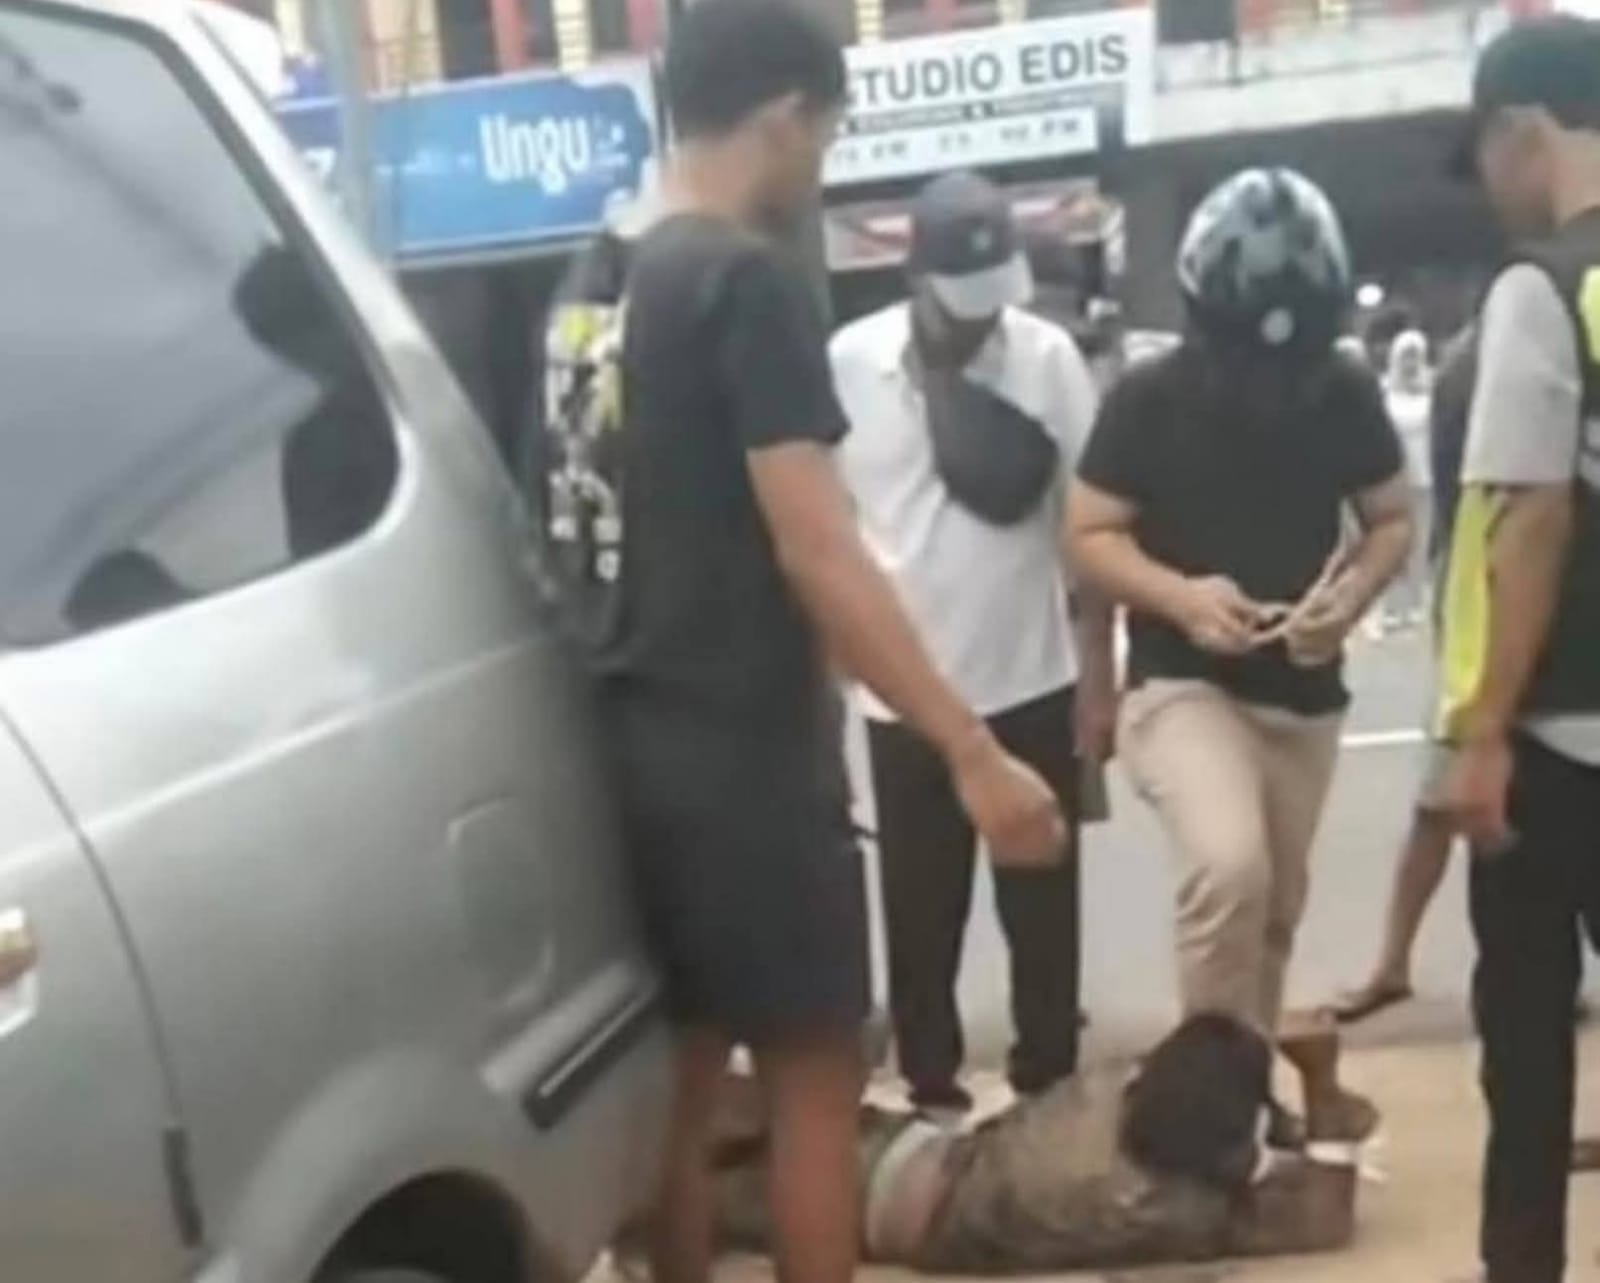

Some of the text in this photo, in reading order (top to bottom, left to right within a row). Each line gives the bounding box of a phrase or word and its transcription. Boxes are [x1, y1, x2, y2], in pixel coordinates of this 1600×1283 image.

[846, 34, 1128, 106] TUDIO EDIS
[480, 113, 590, 194] Ungu
